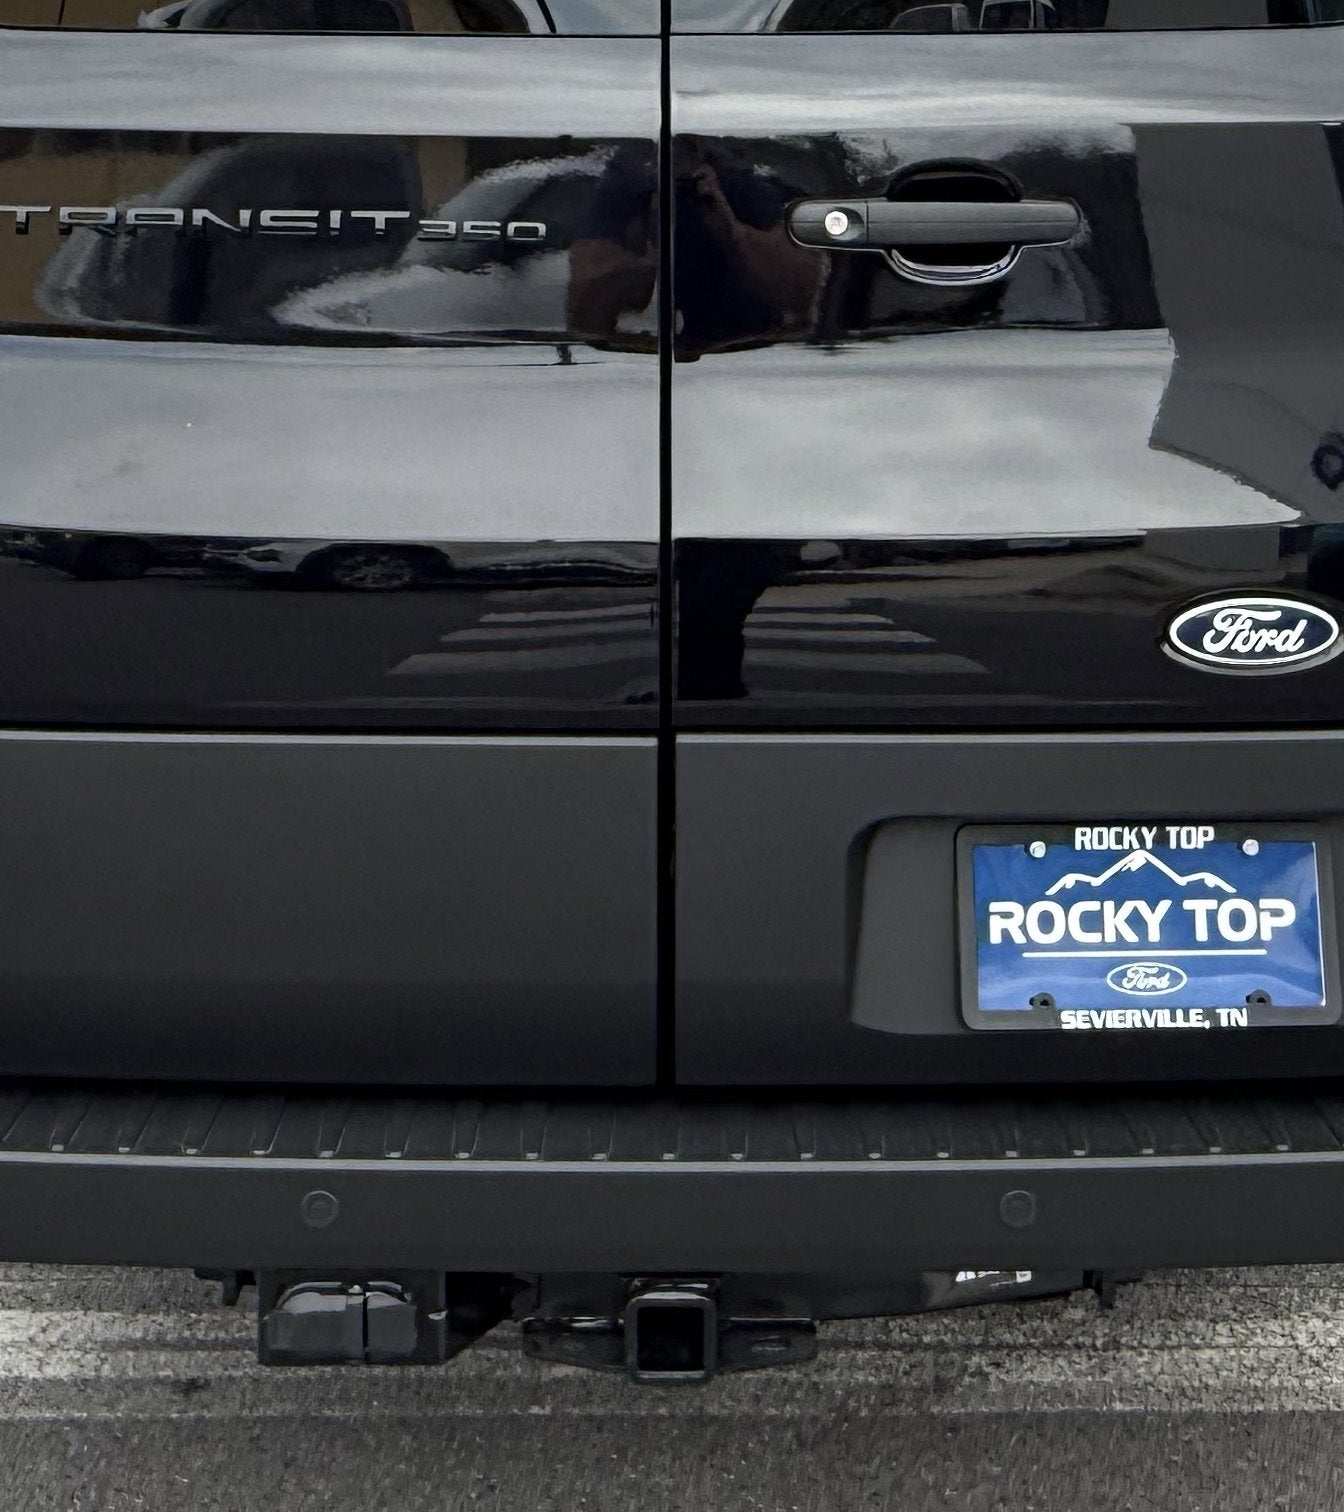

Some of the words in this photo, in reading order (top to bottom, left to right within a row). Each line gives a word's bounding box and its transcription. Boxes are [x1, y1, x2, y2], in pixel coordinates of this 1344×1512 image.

[1202, 607, 1308, 654] Ford
[1074, 825, 1157, 851] ROCKY
[1165, 825, 1215, 850] TOP
[988, 899, 1172, 945] ROCKY
[1182, 898, 1297, 943] TOP
[1121, 965, 1171, 990] Ford
[1060, 1008, 1211, 1030] SEVIERVILLE,
[1215, 1007, 1248, 1028] TN
